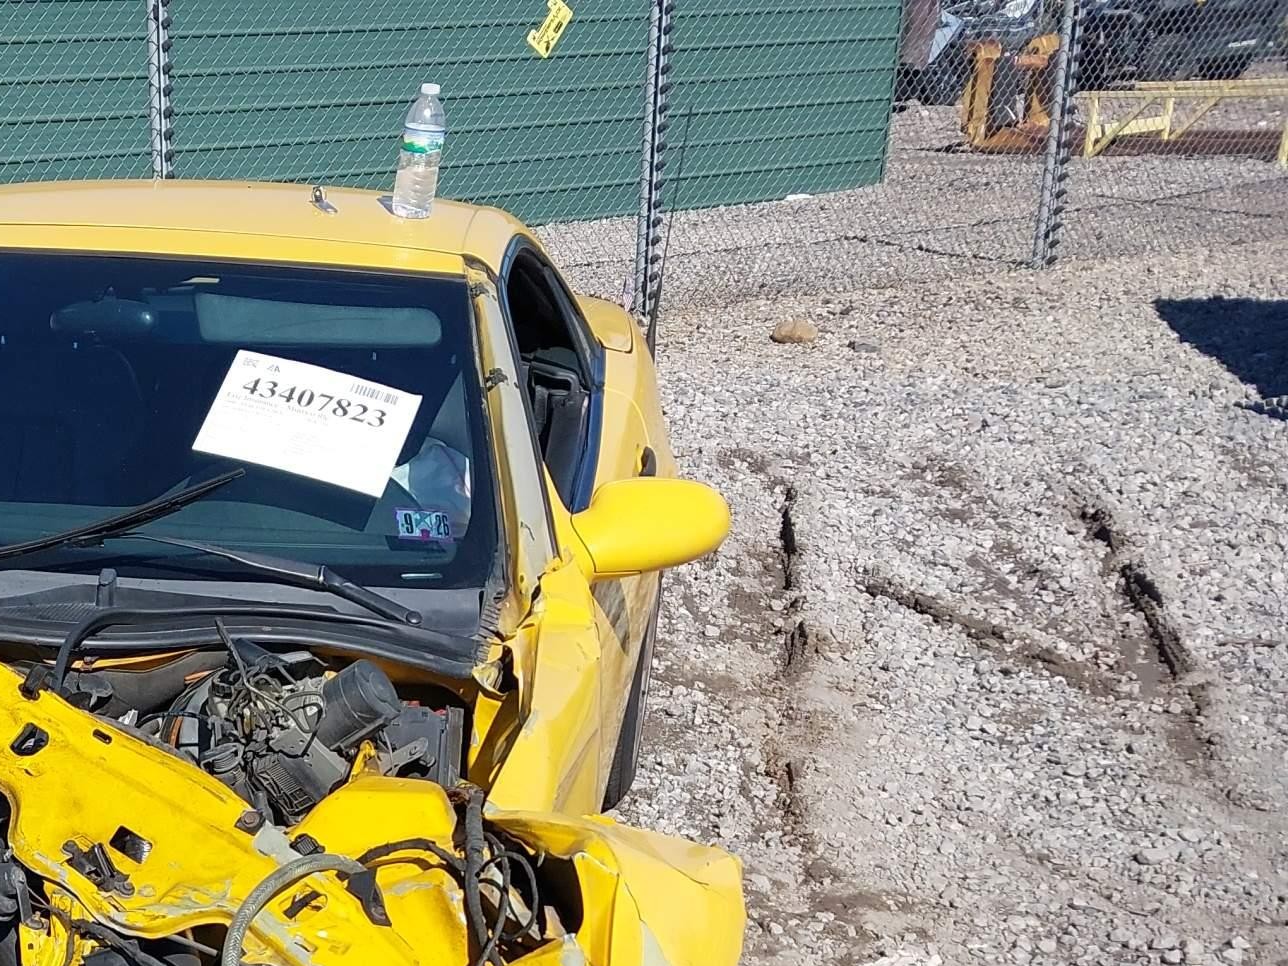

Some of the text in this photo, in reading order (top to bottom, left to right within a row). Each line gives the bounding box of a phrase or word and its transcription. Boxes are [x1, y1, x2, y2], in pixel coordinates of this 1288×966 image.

[242, 377, 388, 428] 43407823
[403, 513, 450, 536] 9 26
